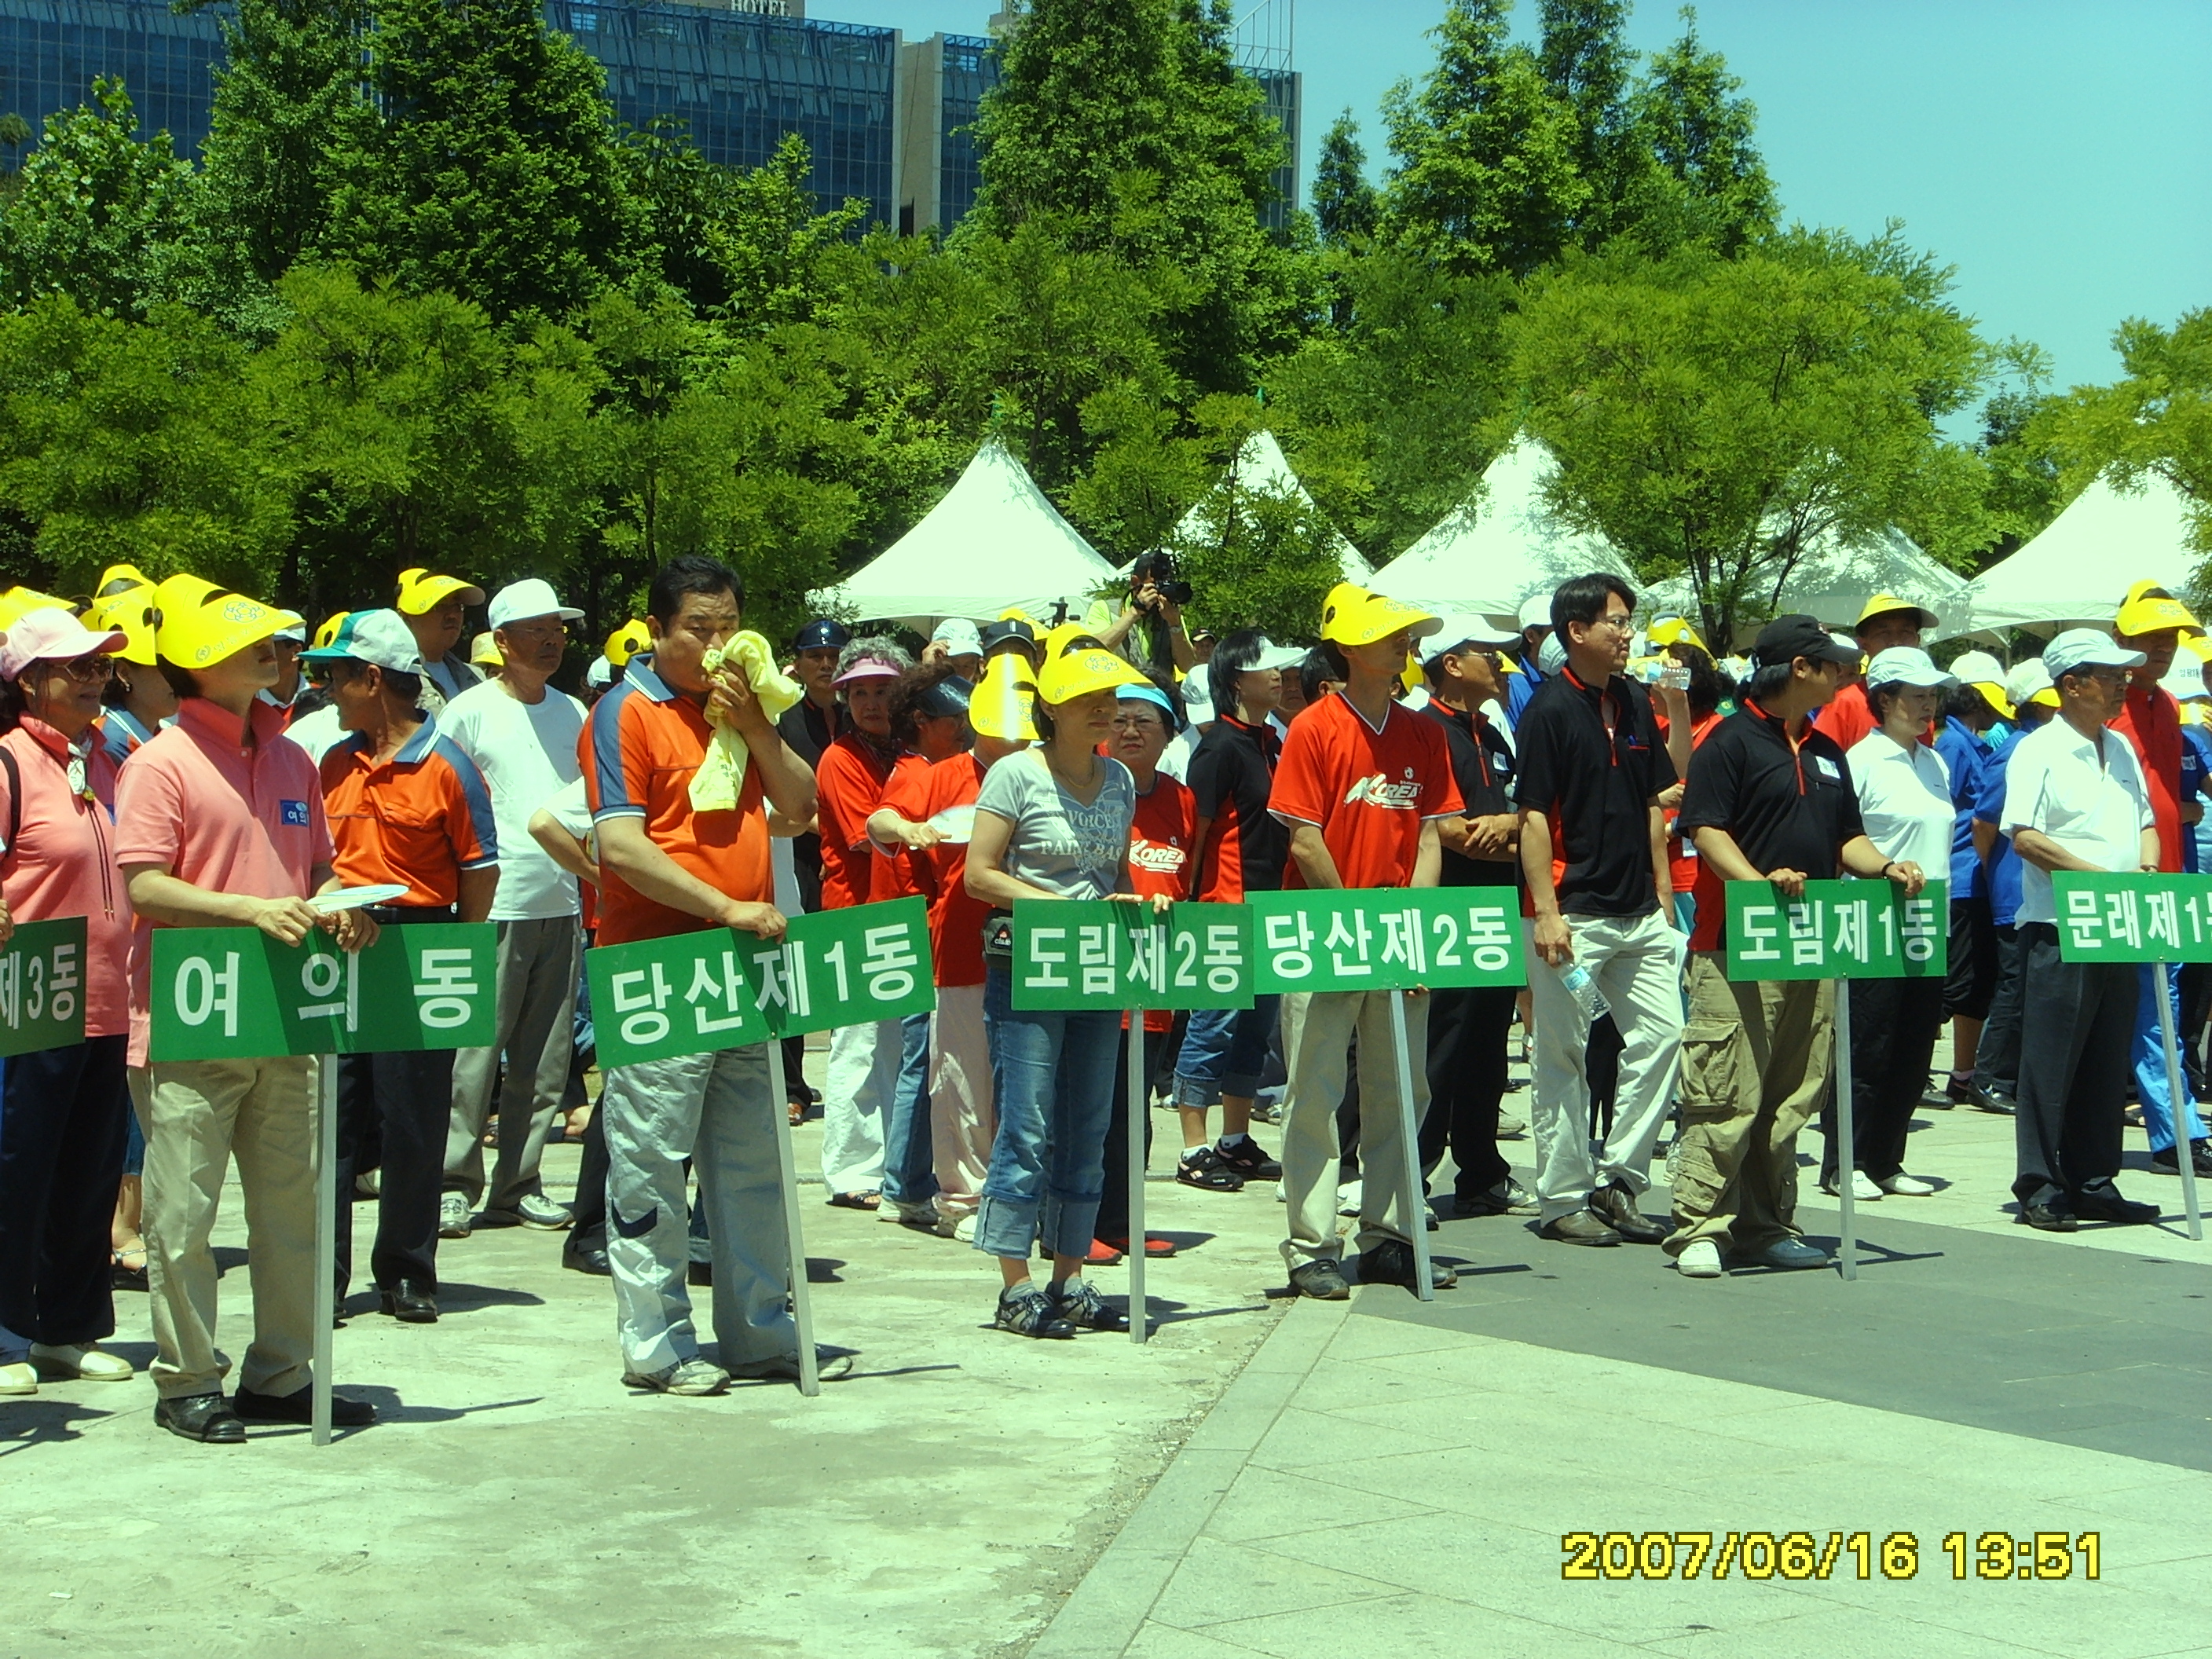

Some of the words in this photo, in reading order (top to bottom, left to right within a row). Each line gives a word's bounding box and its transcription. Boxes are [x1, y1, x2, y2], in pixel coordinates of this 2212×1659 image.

[1265, 907, 1512, 979] 당산제2동
[1739, 899, 1937, 965] 도림제1동
[2067, 889, 2212, 949] 문래제1
[611, 923, 917, 1045] 당산제1동
[1025, 922, 1243, 994] 도림제2동
